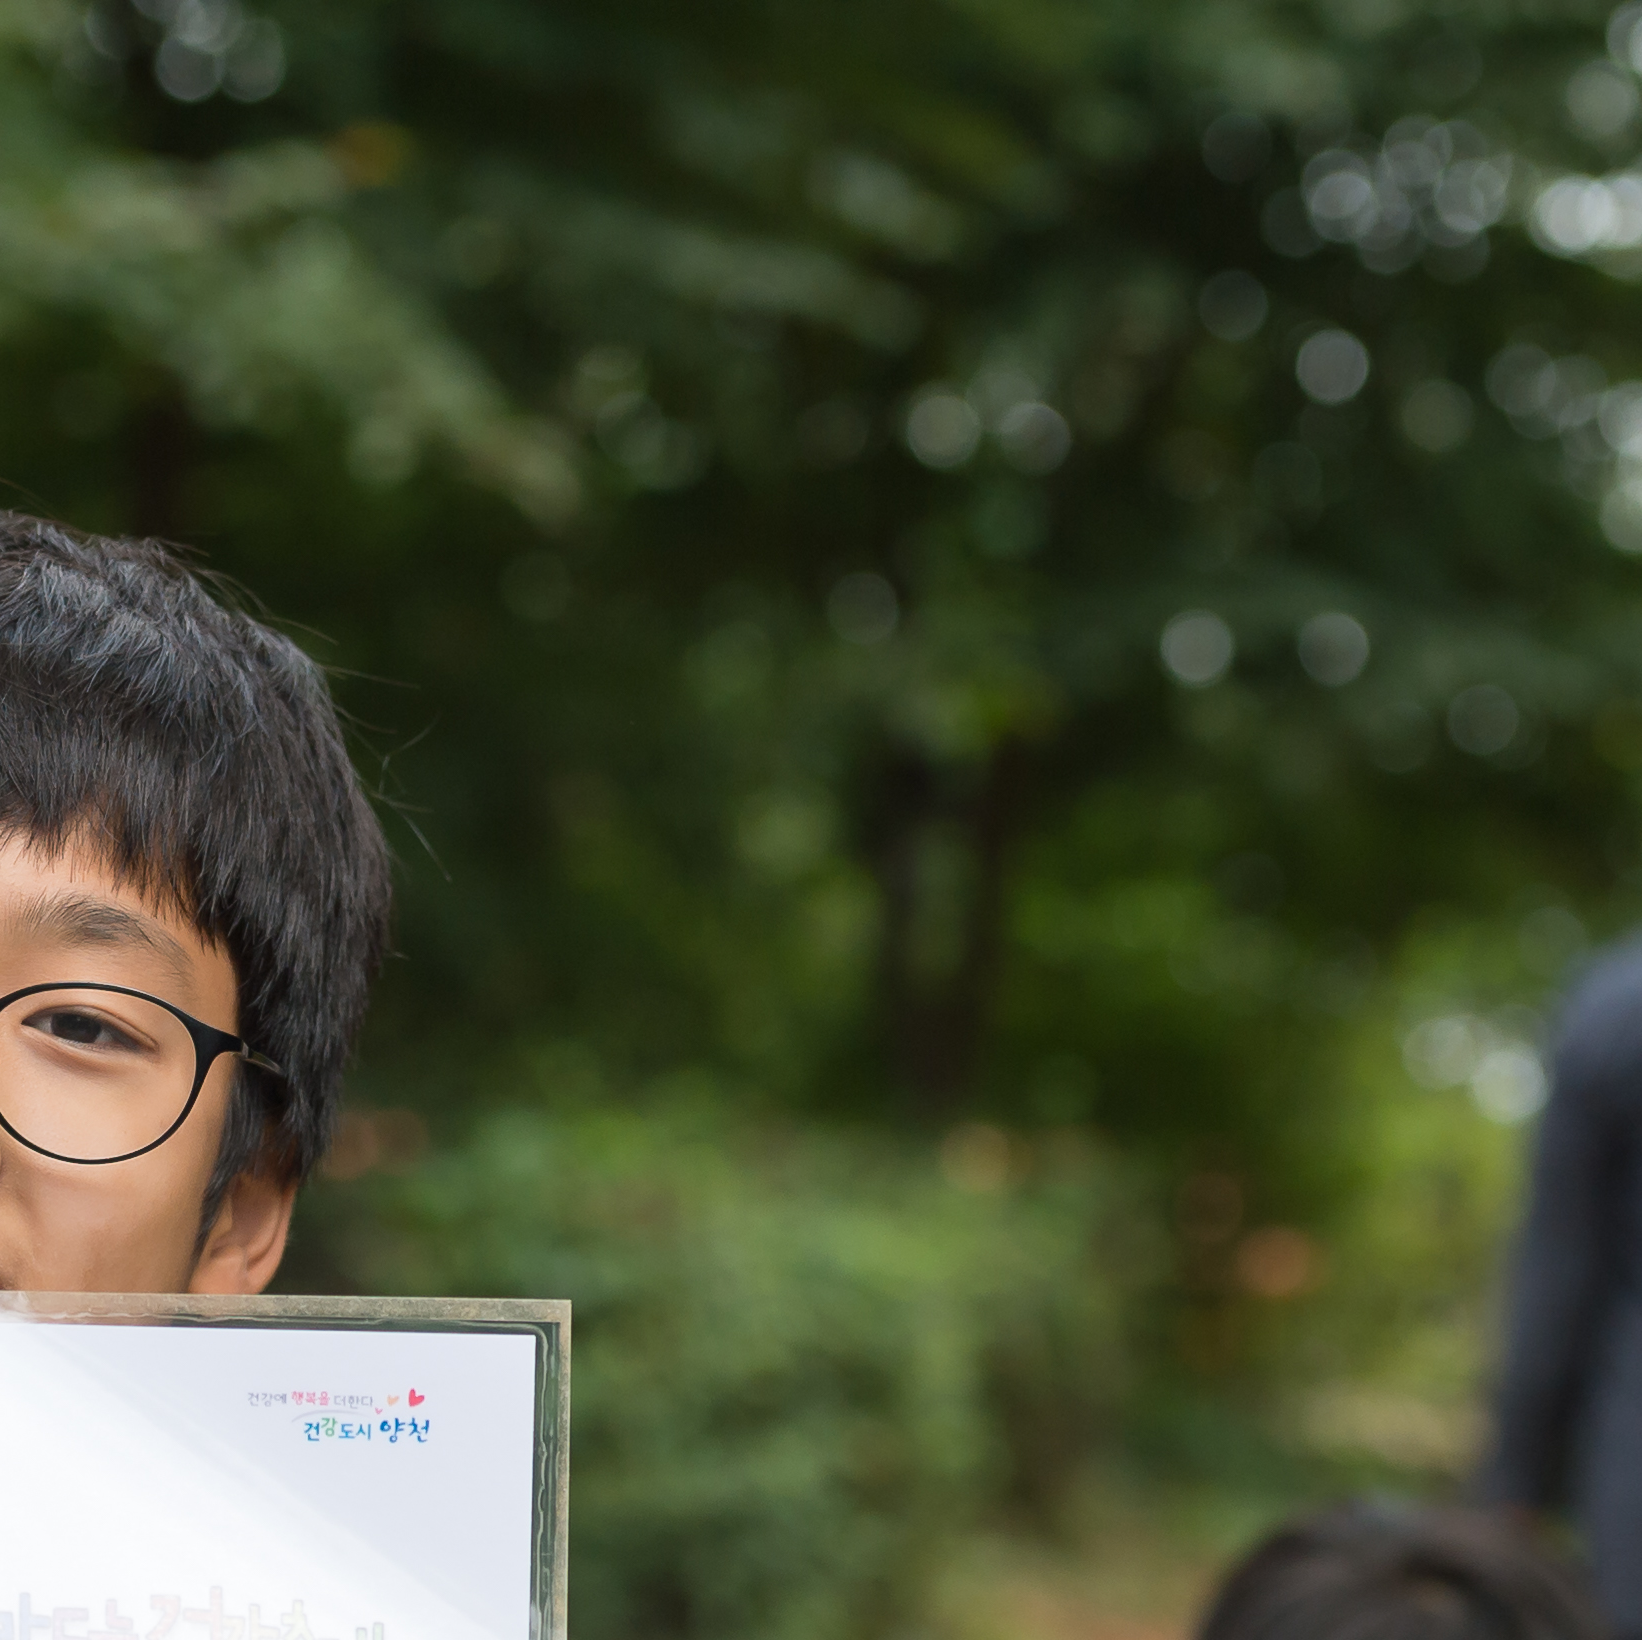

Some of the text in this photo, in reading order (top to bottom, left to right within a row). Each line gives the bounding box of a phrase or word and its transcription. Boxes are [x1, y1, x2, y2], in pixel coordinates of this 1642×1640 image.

[247, 1391, 374, 1409] 건강에 행복을 더한다
[304, 1417, 430, 1443] 건강도시 양천
